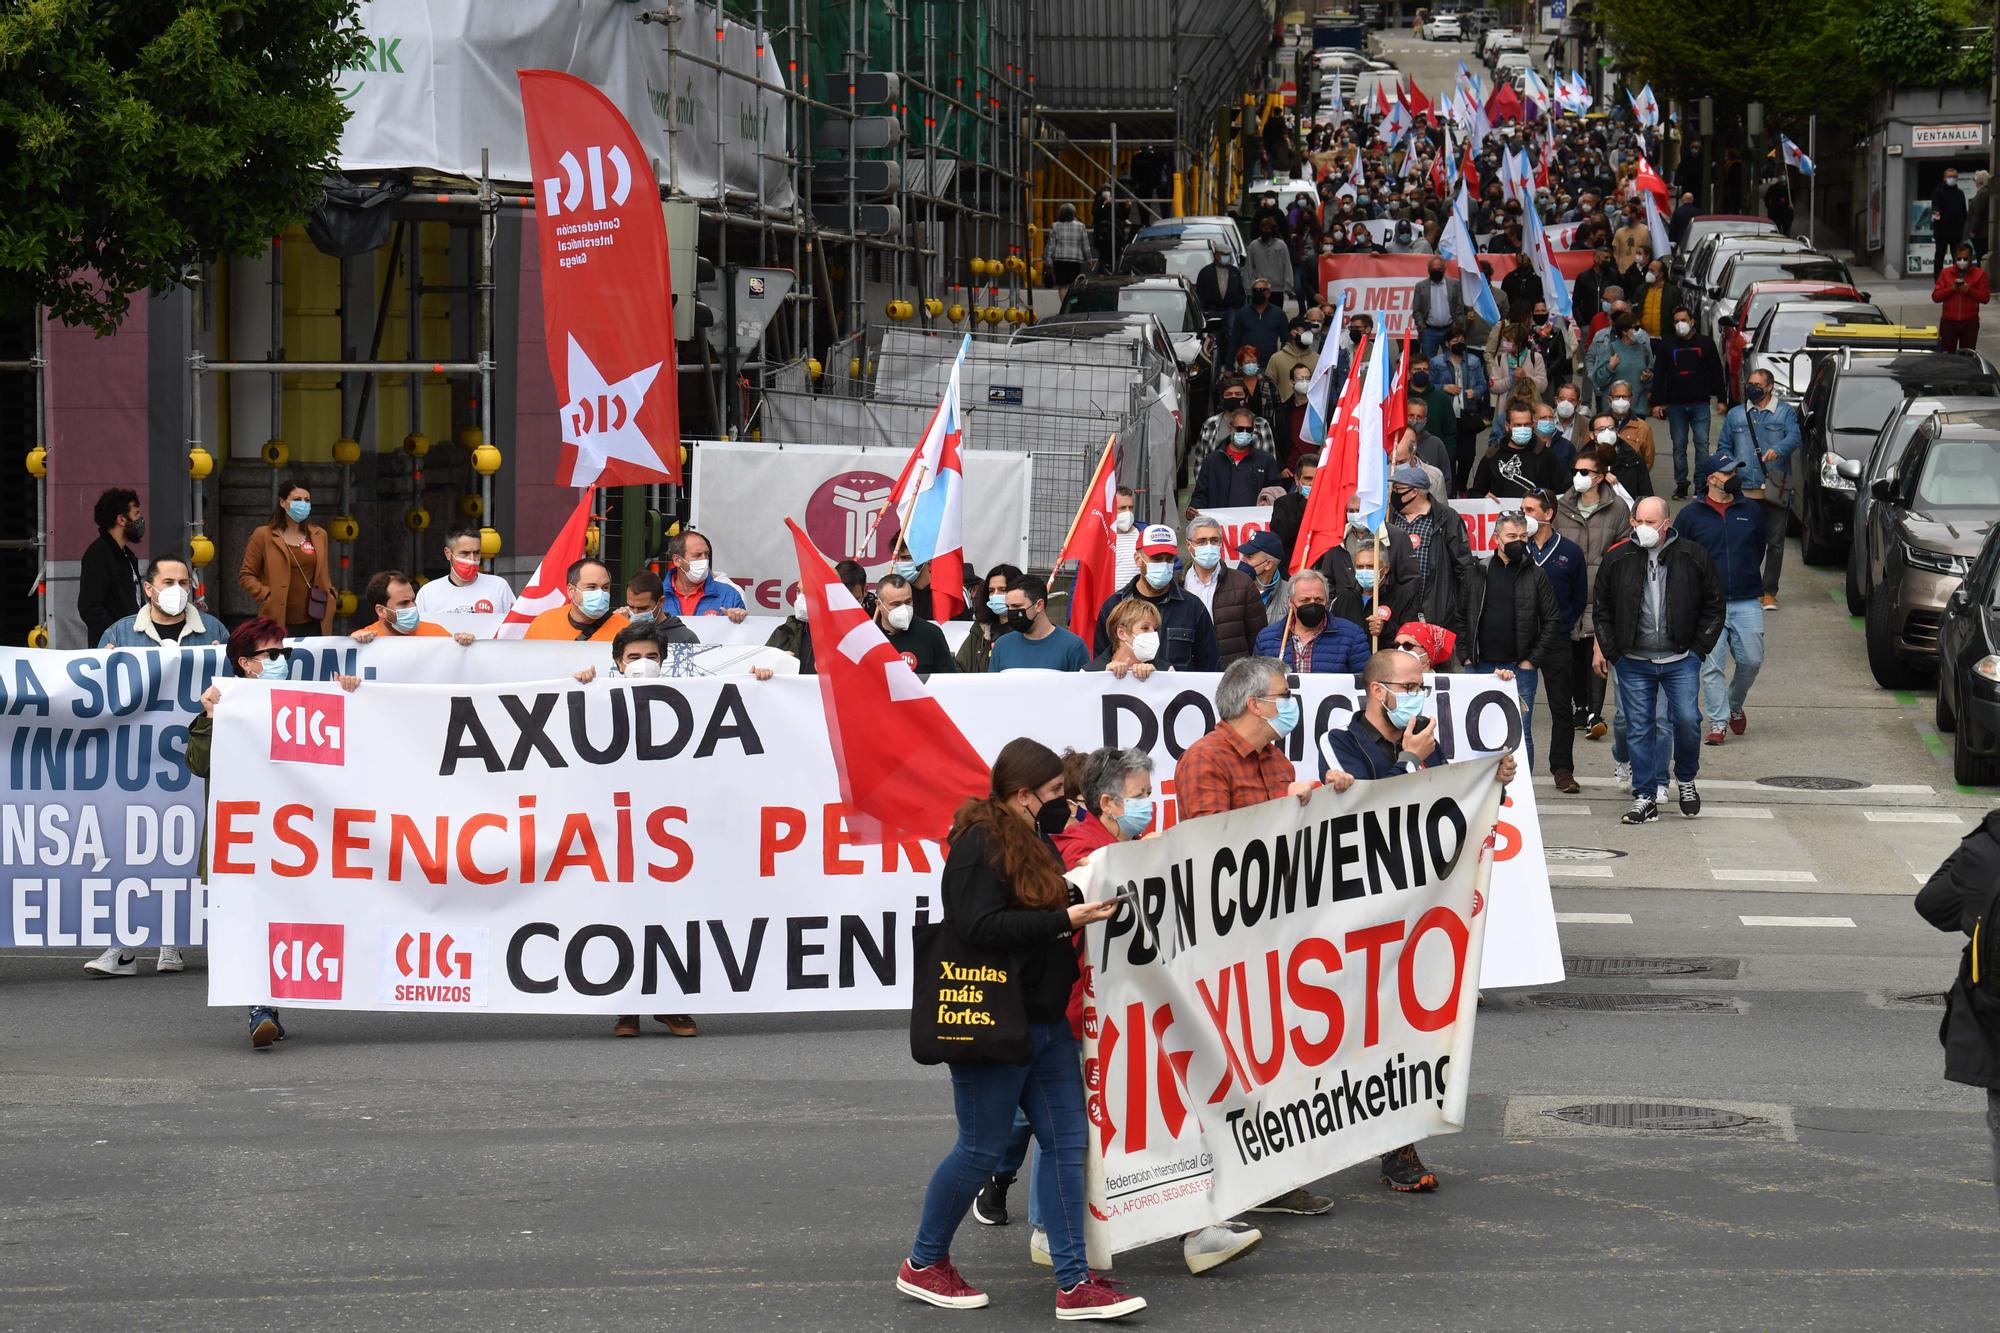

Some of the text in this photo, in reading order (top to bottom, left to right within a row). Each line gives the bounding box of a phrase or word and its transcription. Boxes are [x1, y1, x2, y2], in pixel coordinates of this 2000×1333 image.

[1364, 286, 1415, 311] MET
[275, 705, 342, 750] CIG
[439, 683, 765, 776] AXUDA
[125, 804, 196, 866] DO
[1211, 796, 1468, 937] CONVENIO
[272, 940, 339, 983] CIG
[395, 932, 472, 980] CIG
[940, 961, 1007, 983] Xuntas
[395, 985, 471, 1003] SERVIZOS
[937, 1004, 996, 1025] fortes.
[939, 985, 984, 1003] máis
[1196, 906, 1470, 1104] XUSTO
[1098, 1001, 1197, 1159] CIG
[1151, 1154, 1198, 1179] Intersindical
